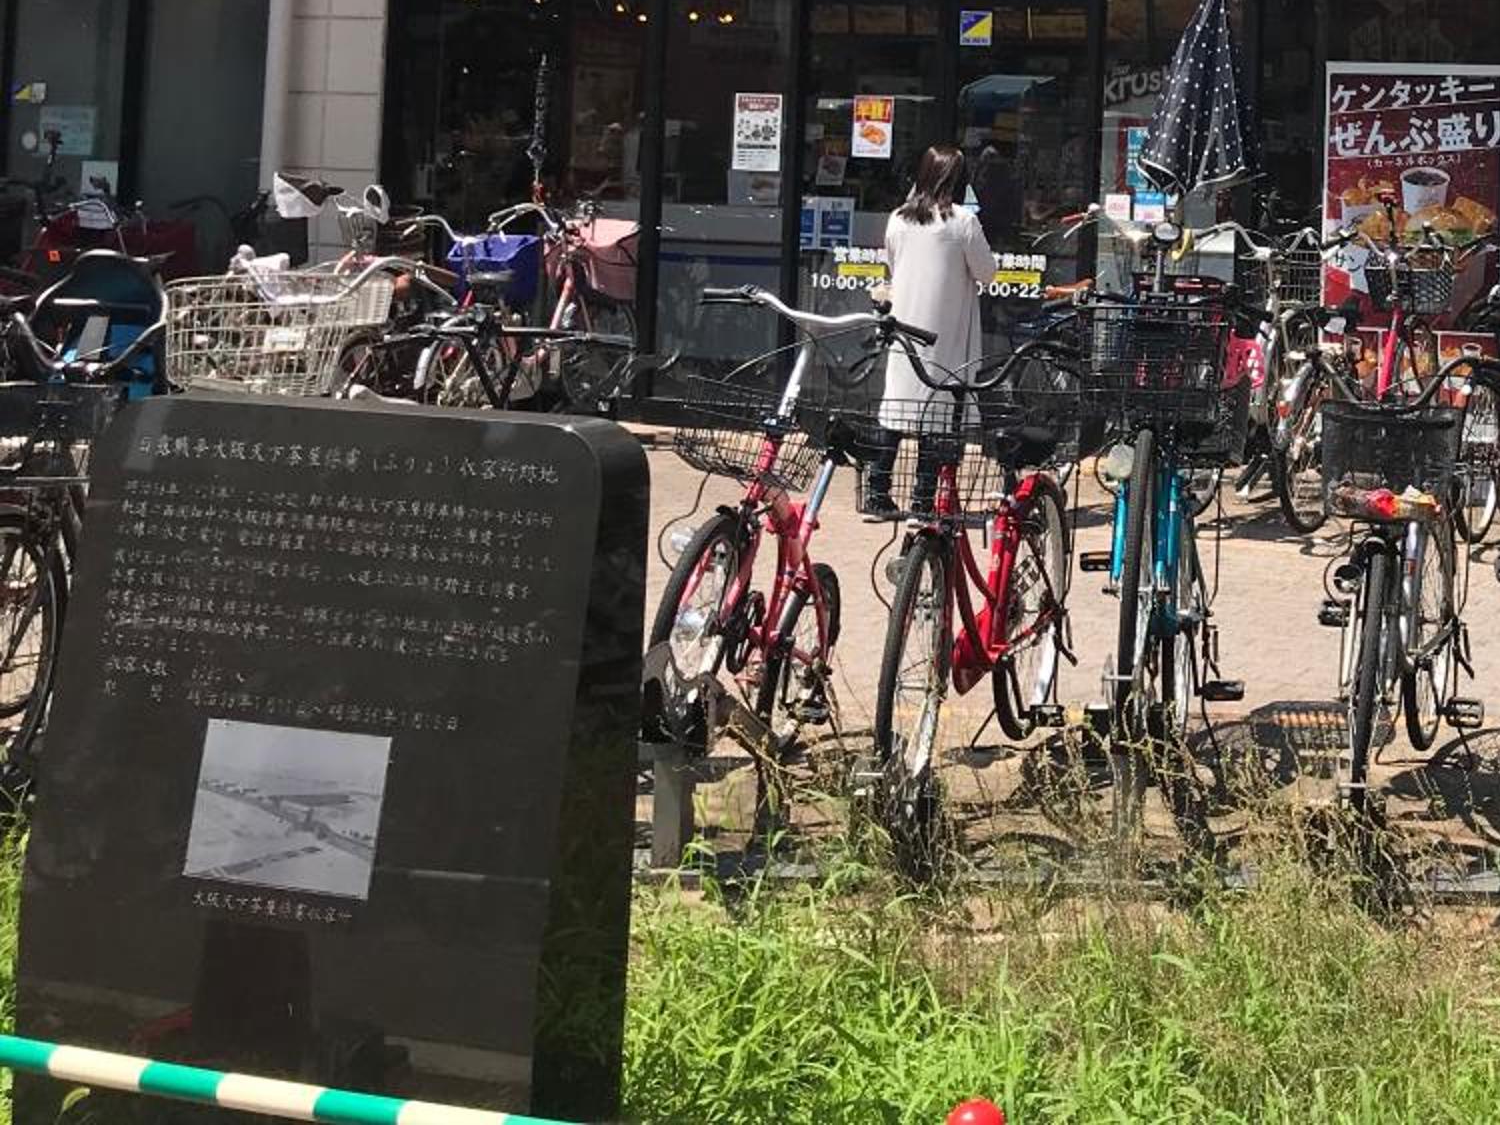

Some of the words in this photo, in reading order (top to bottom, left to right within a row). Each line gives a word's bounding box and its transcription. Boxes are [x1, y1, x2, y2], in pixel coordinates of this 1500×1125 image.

[1331, 76, 1495, 113] ケンタッキー
